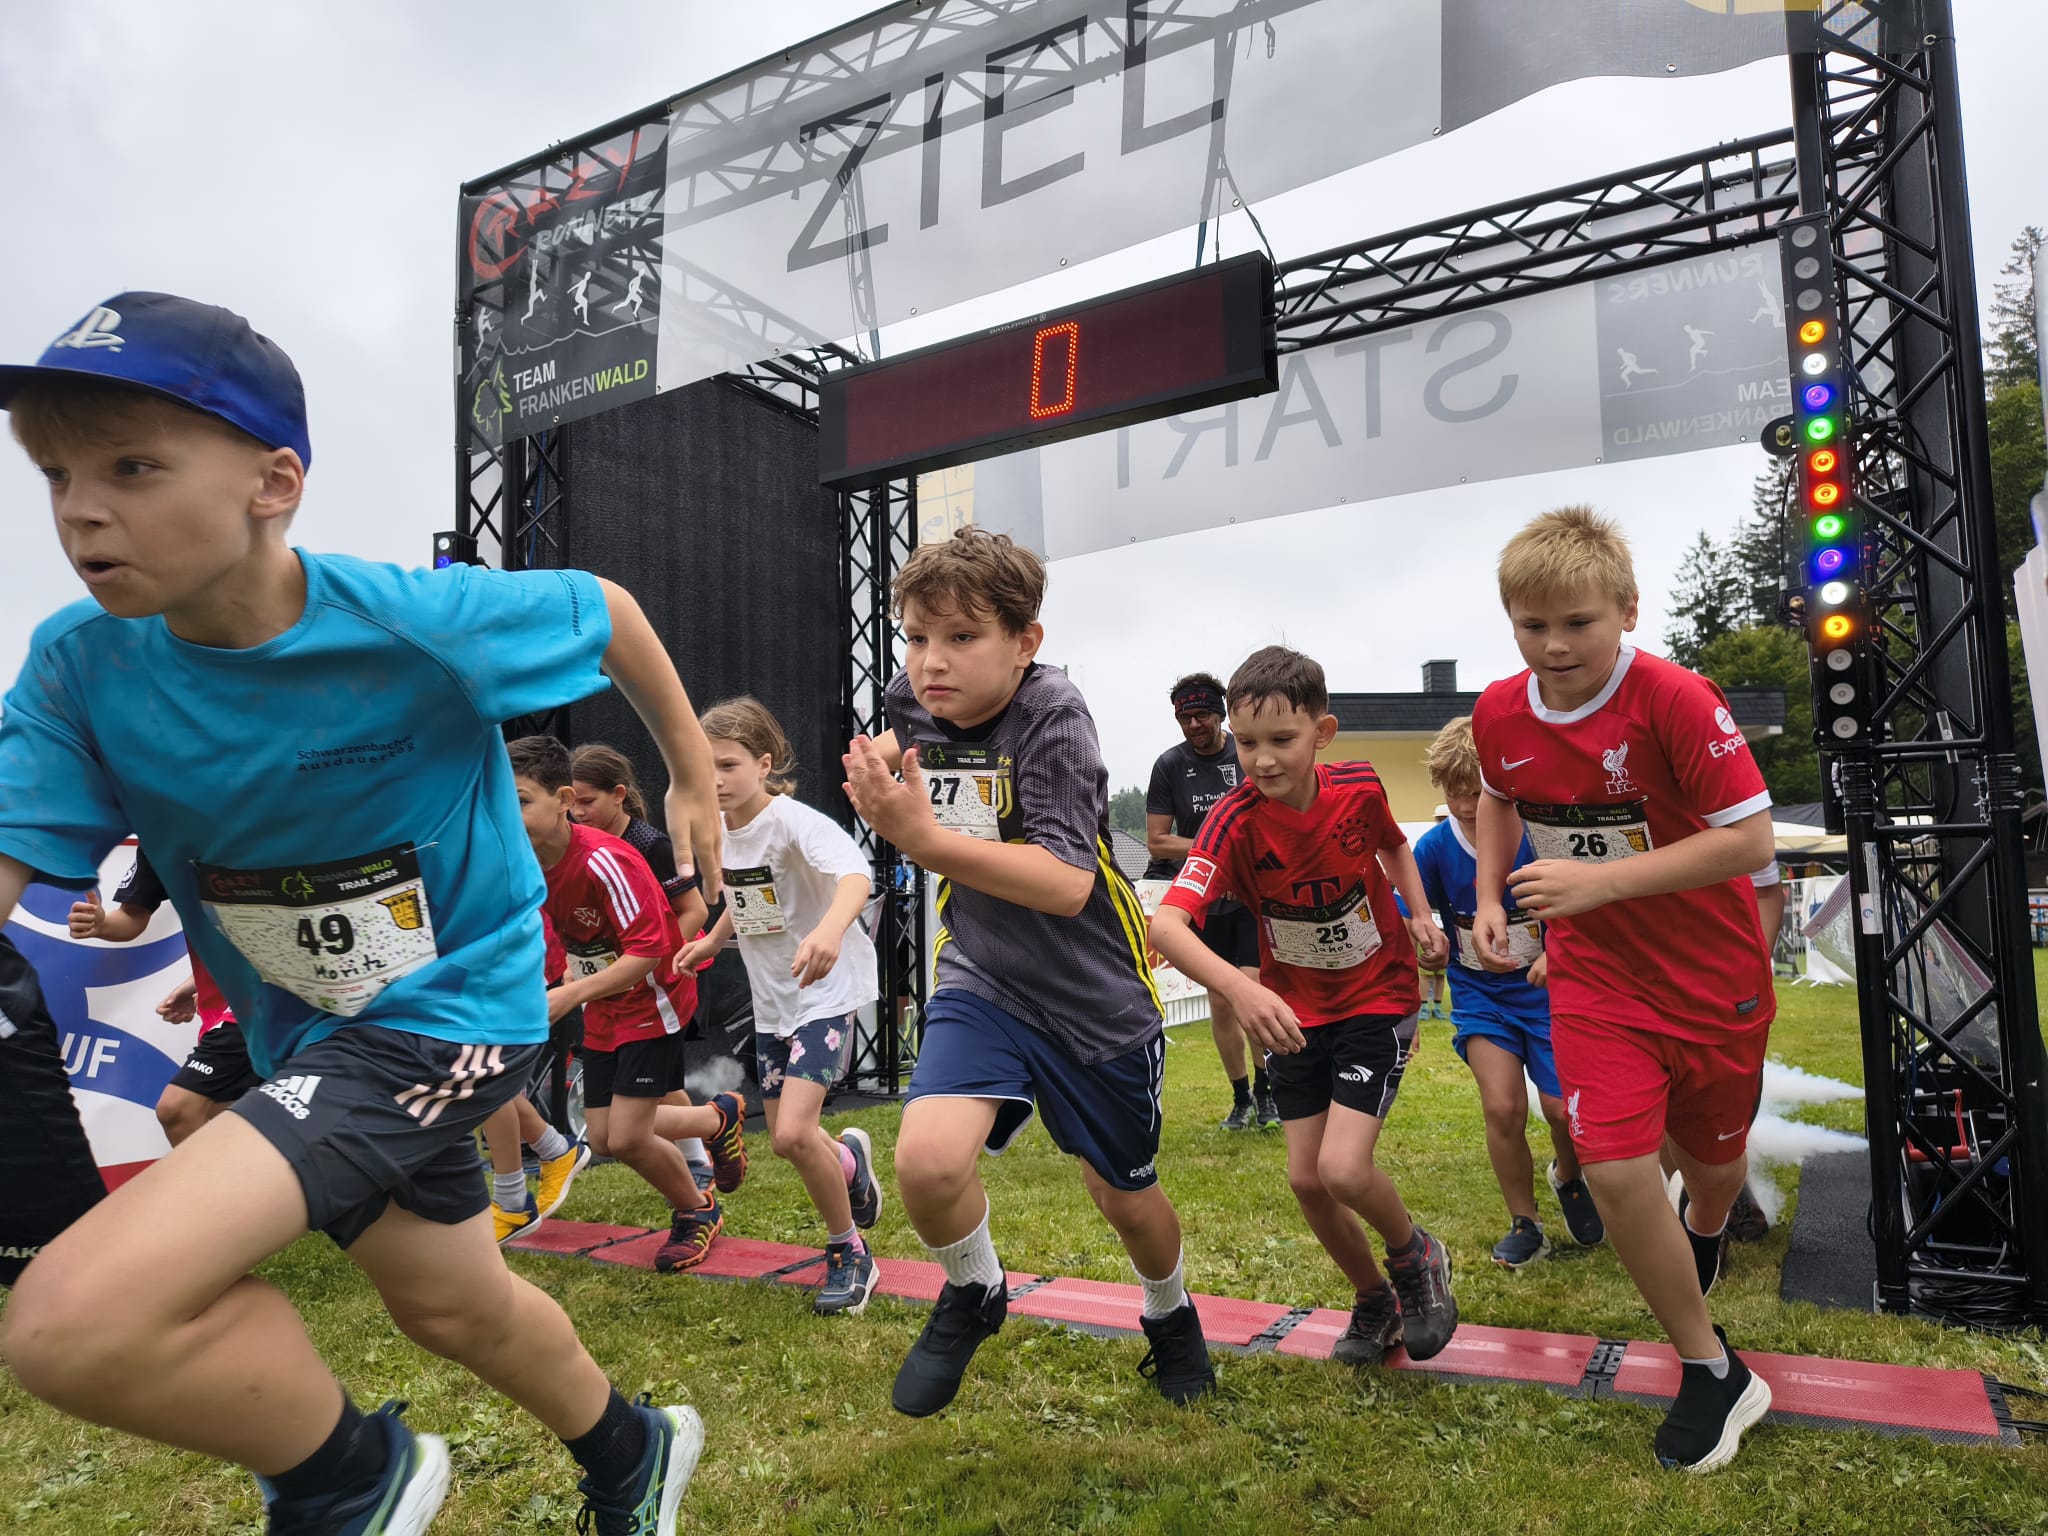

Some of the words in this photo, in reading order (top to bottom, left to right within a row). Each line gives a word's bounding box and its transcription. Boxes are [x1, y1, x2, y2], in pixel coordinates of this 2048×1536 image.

[787, 0, 1226, 272] ZIEL
[513, 360, 556, 392] TEAM
[1030, 321, 1079, 419] 0
[518, 358, 649, 419] FRANKENWALD
[929, 777, 961, 806] 27
[1568, 833, 1608, 857] 26
[337, 877, 373, 892] TRAIL
[372, 868, 400, 884] 2025
[734, 891, 747, 908] 5
[297, 913, 355, 956] 49
[1316, 922, 1349, 944] 25
[314, 954, 388, 980] Moritz
[579, 960, 599, 976] 28
[188, 1060, 214, 1076] JAKO
[258, 1084, 311, 1120] adidas
